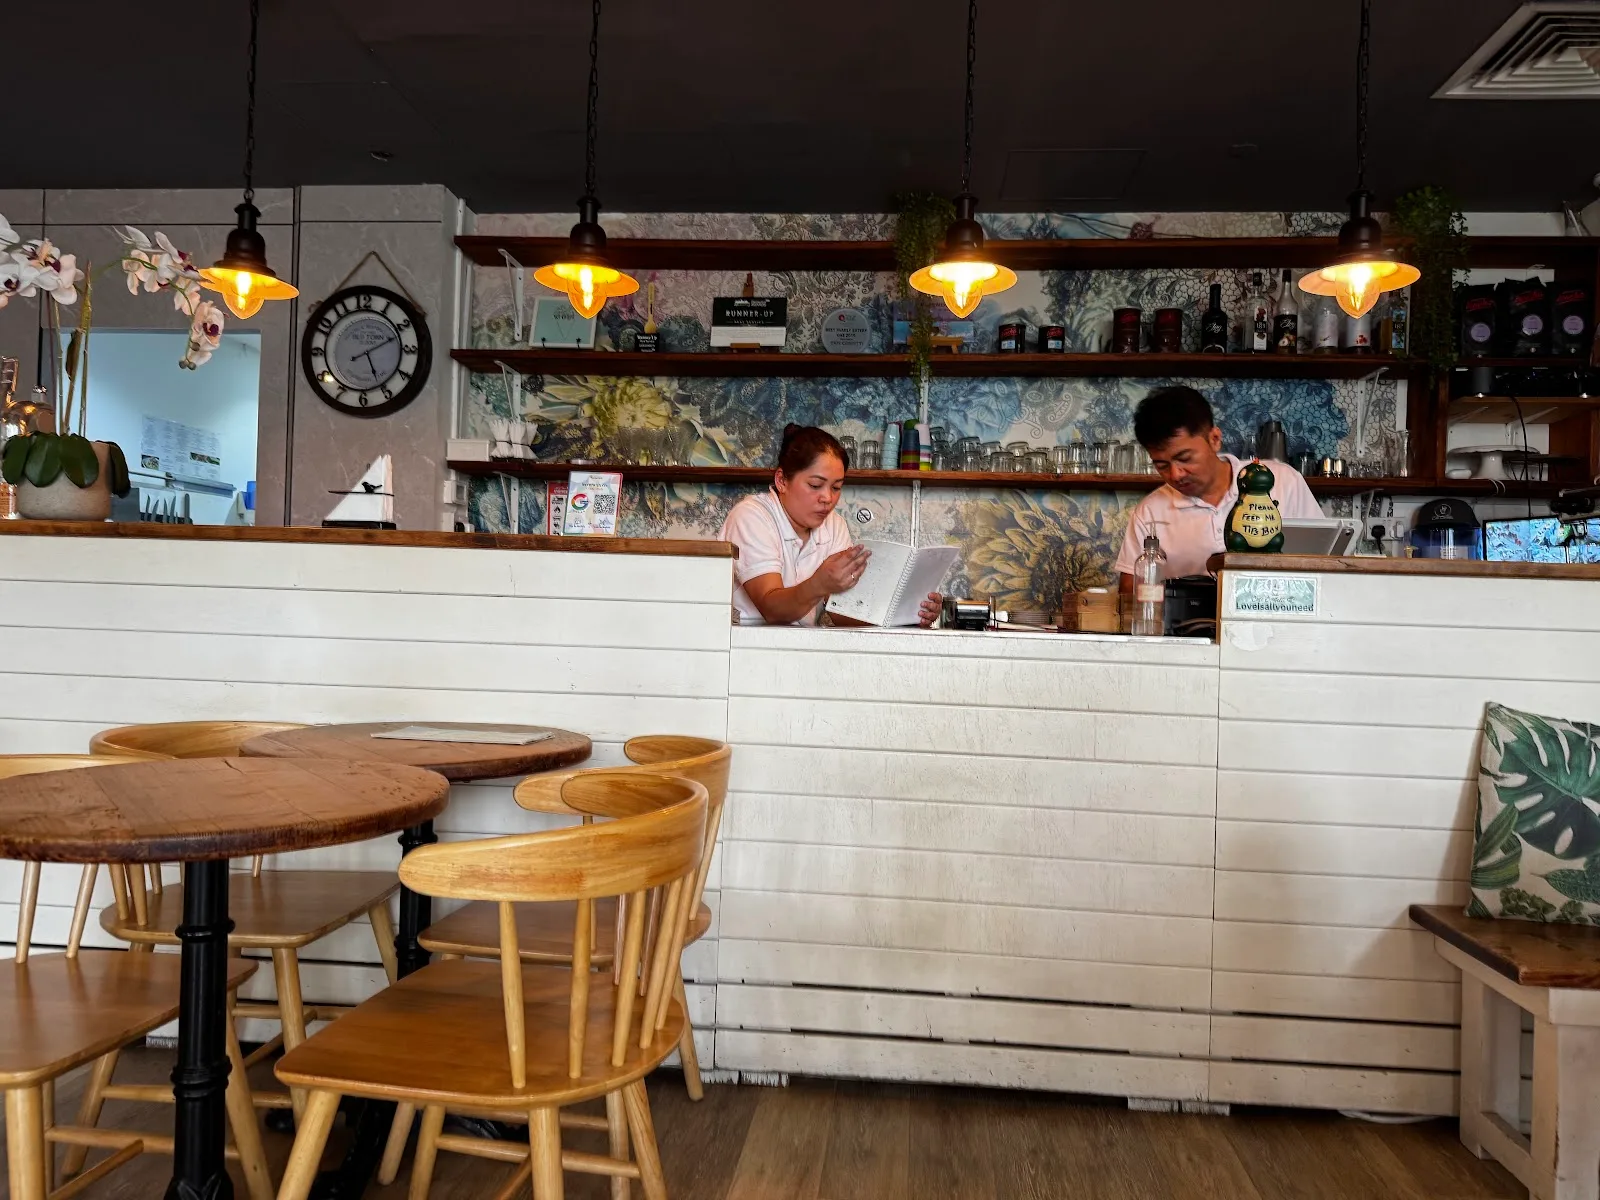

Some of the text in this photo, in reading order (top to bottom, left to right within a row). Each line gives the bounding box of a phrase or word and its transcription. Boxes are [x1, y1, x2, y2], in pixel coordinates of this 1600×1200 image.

[356, 294, 371, 309] 12
[381, 301, 392, 315] 1
[333, 300, 351, 319] 11
[725, 309, 774, 318] RUNNER-UP
[317, 317, 332, 337] 10
[397, 319, 411, 331] 2
[311, 347, 325, 357] 9
[403, 344, 418, 354] 3
[397, 369, 412, 381] 4
[335, 385, 347, 400] 7
[381, 384, 392, 400] 5
[359, 392, 368, 407] 6
